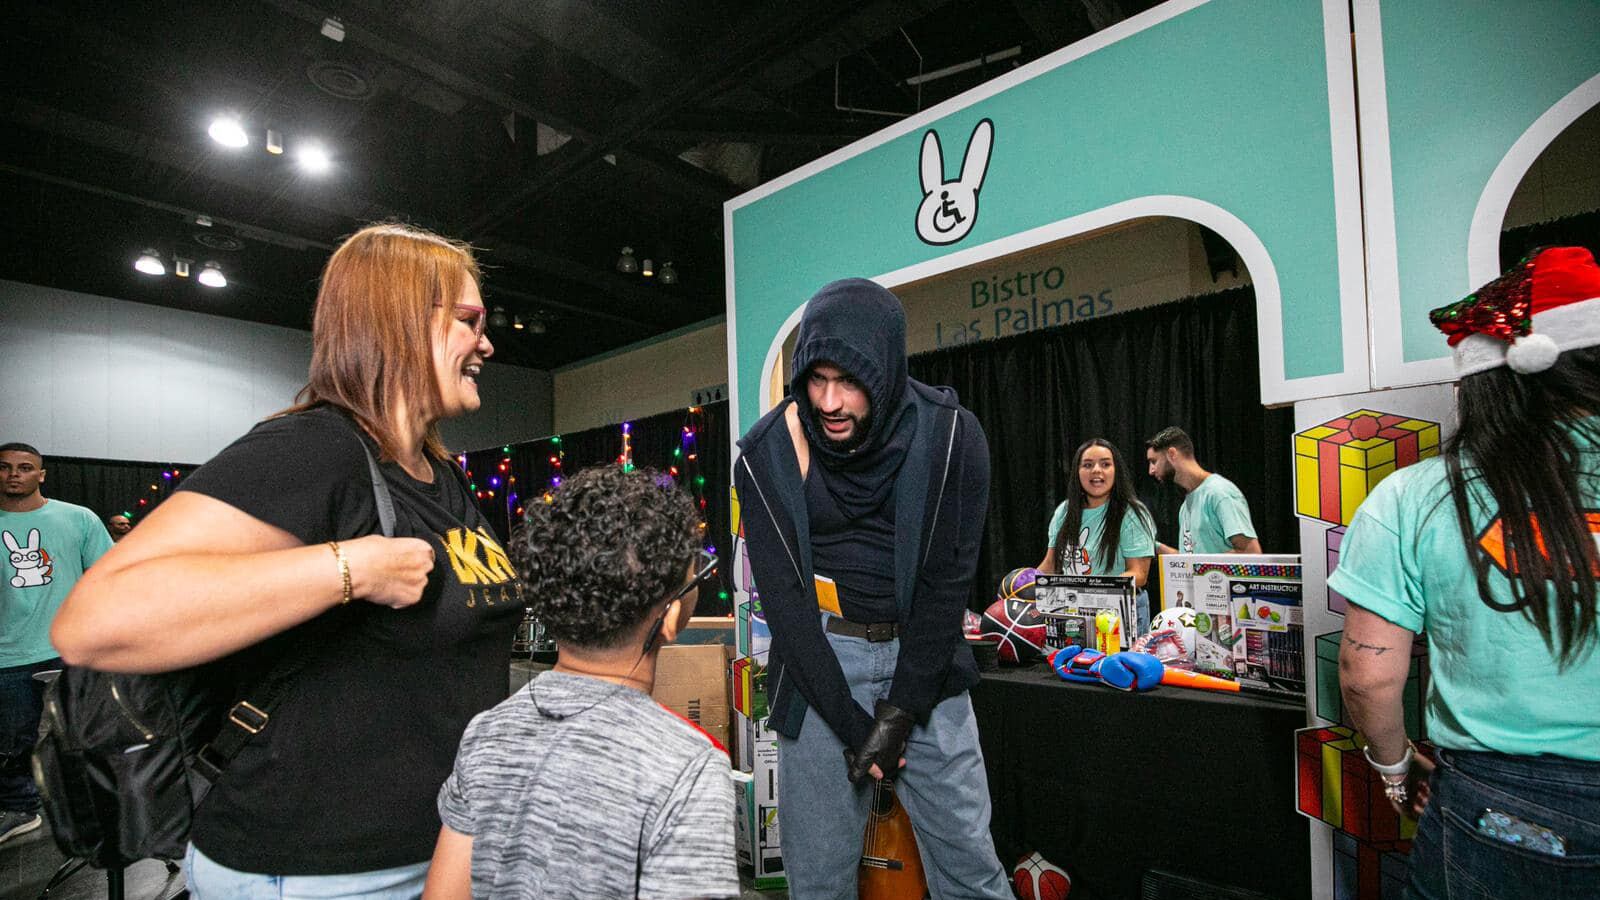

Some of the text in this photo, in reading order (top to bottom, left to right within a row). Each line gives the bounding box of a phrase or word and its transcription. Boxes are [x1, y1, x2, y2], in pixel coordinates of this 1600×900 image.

[971, 266, 1065, 309] Bistro
[936, 288, 1114, 350] Las Palmas
[1169, 561, 1186, 569] SKLZ
[1260, 584, 1299, 593] INSTRUCTOR
